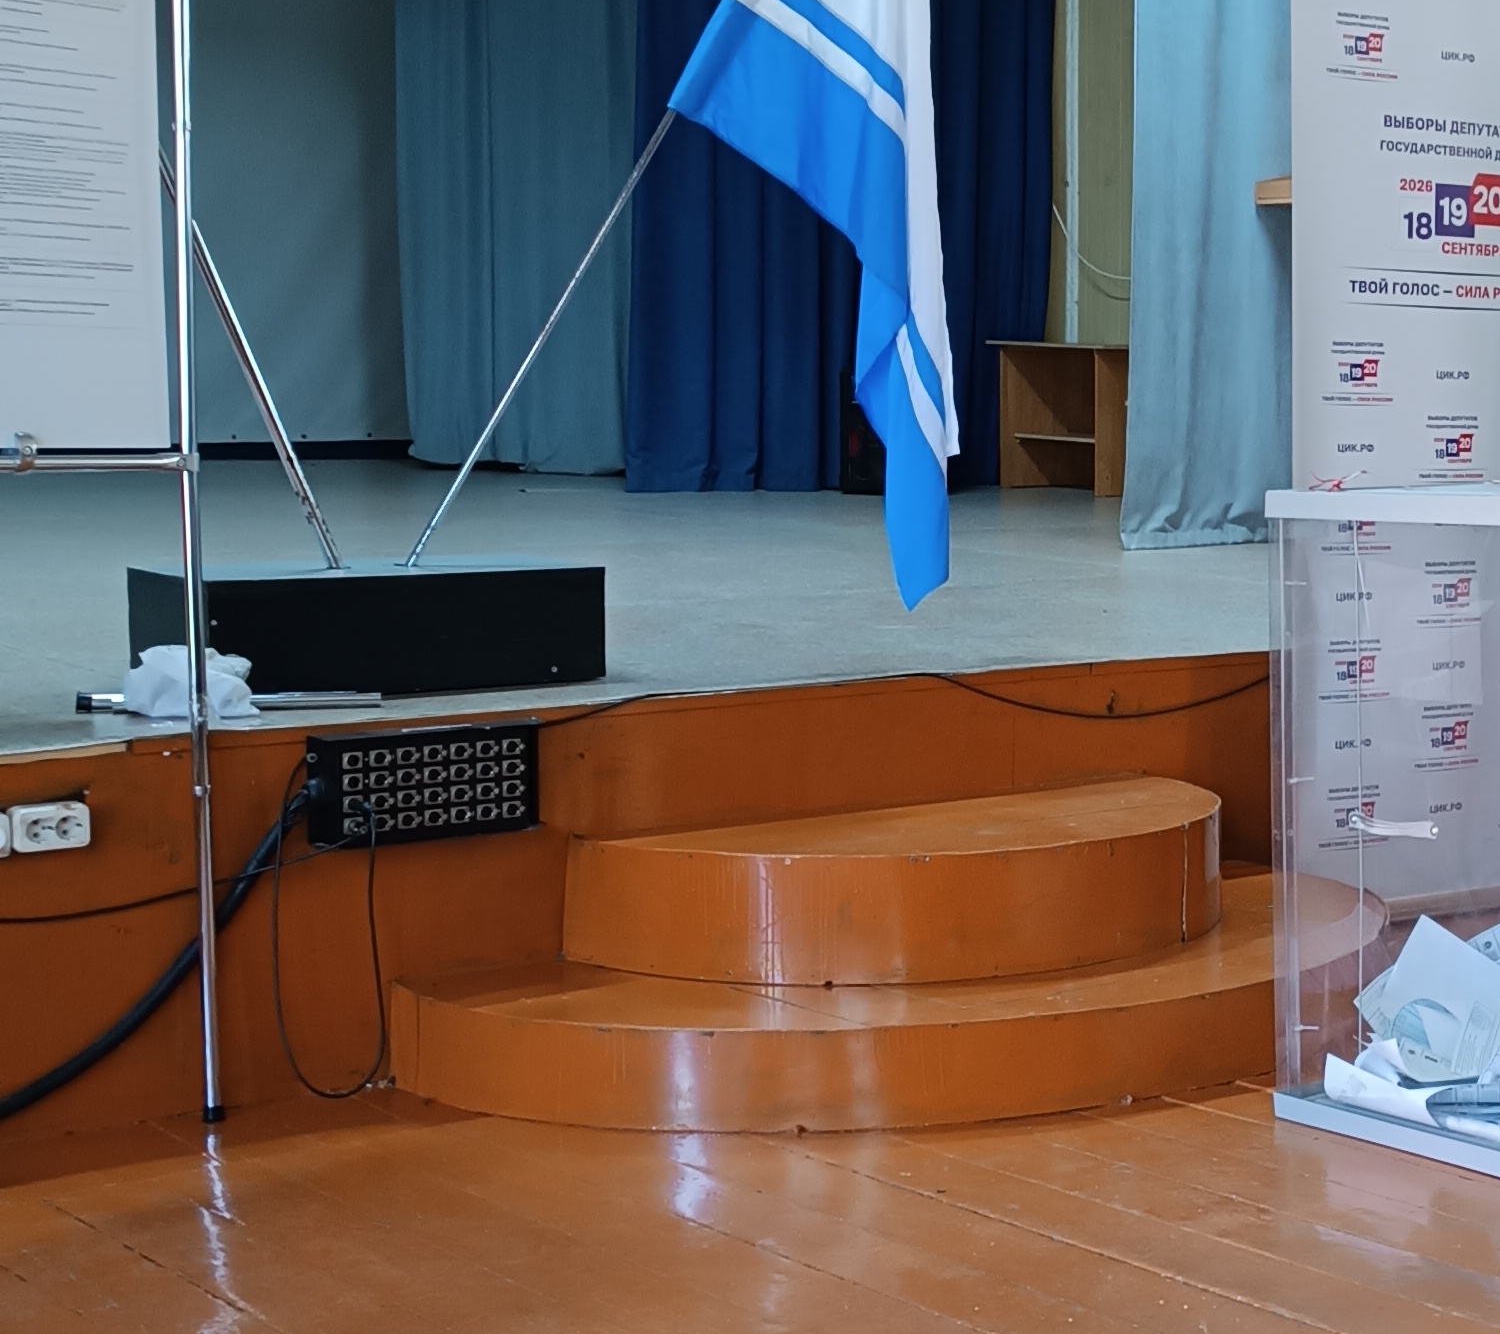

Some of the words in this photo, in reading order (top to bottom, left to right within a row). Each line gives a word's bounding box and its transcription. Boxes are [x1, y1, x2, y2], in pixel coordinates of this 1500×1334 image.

[1368, 37, 1381, 48] 20
[1441, 50, 1475, 63] ЦИК.РФ
[1383, 114, 1446, 132] ВЫБОРЫ
[1380, 139, 1492, 160] ГОСУДАРСТВЕННОЙ
[1400, 178, 1433, 193] 2026
[1403, 211, 1432, 240] 18
[1439, 196, 1468, 227] 19
[1349, 278, 1388, 295] ТВОЙ
[1392, 282, 1440, 296] ГОЛОС
[1455, 285, 1490, 299] СИЛА
[1339, 373, 1349, 383] 18
[1364, 362, 1376, 374] 20
[1436, 370, 1469, 380] ЦИК.РФ
[1337, 443, 1374, 453] ЦИК.РФ
[1435, 449, 1445, 459] 18
[1447, 443, 1457, 454] 19
[1459, 437, 1470, 448] 20
[1336, 591, 1373, 603] ЦИКРФ
[1433, 594, 1443, 605] 18
[1456, 582, 1468, 593] 20
[1336, 671, 1347, 681] 18
[1361, 659, 1374, 670] 20
[1430, 737, 1441, 748] 18
[1442, 731, 1453, 742] 19
[1454, 725, 1466, 736] 20
[1429, 802, 1462, 814] ЦИК.РФ
[1336, 818, 1346, 828] 18
